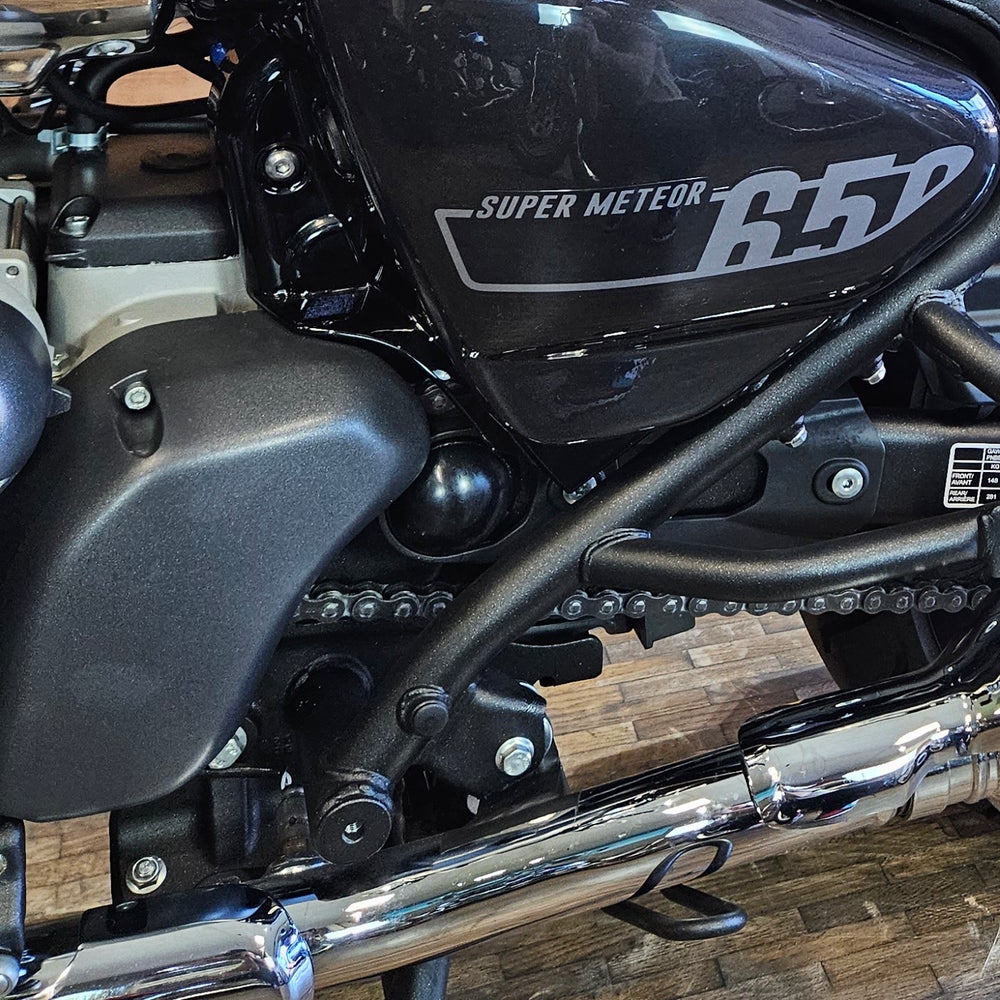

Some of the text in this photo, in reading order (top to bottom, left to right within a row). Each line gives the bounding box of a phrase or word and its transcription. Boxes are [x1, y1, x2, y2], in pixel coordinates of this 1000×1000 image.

[476, 180, 707, 220] SUPER METEOR
[697, 145, 974, 273] 650
